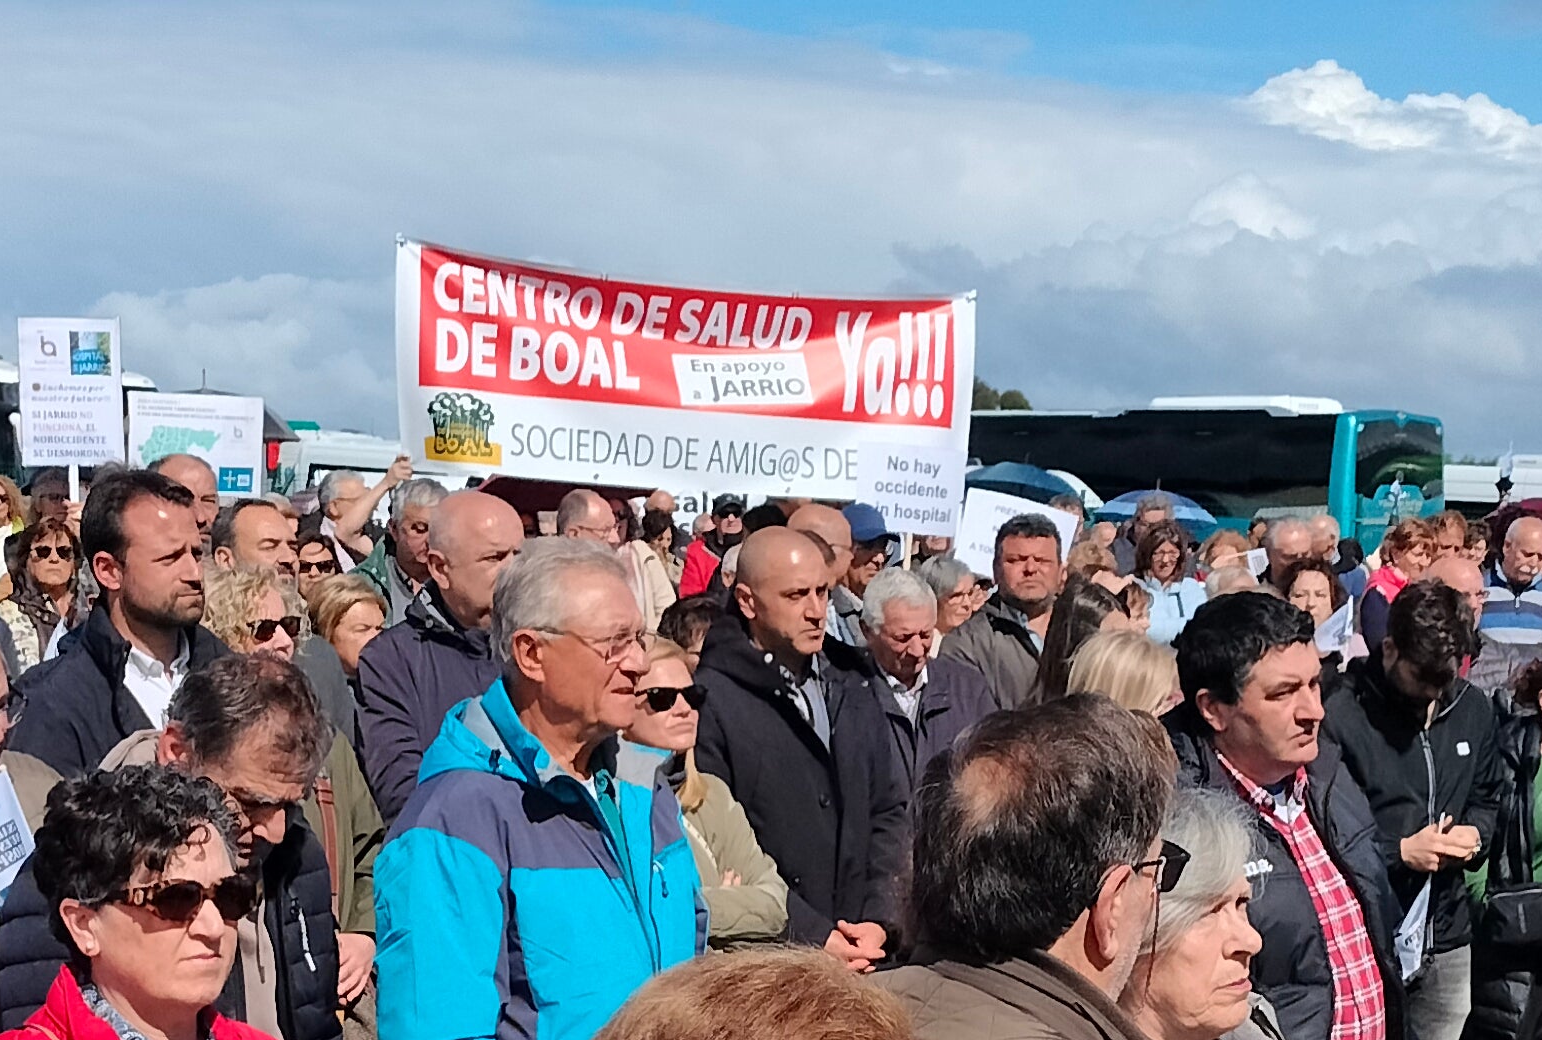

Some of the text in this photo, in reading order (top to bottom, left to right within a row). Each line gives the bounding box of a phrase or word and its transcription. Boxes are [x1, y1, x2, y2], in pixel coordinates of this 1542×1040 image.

[433, 262, 812, 350] CENTRO DE SALUD
[435, 318, 640, 390] DE BOAL
[690, 359, 786, 376] En apoyo
[835, 310, 949, 419] Ya!!!
[693, 376, 806, 403] a JARRIO
[510, 423, 858, 482] SOCIEDAD DE AMIG@S DE
[887, 455, 941, 479] No hay
[875, 480, 948, 499] occidente
[894, 503, 952, 524] hospital
